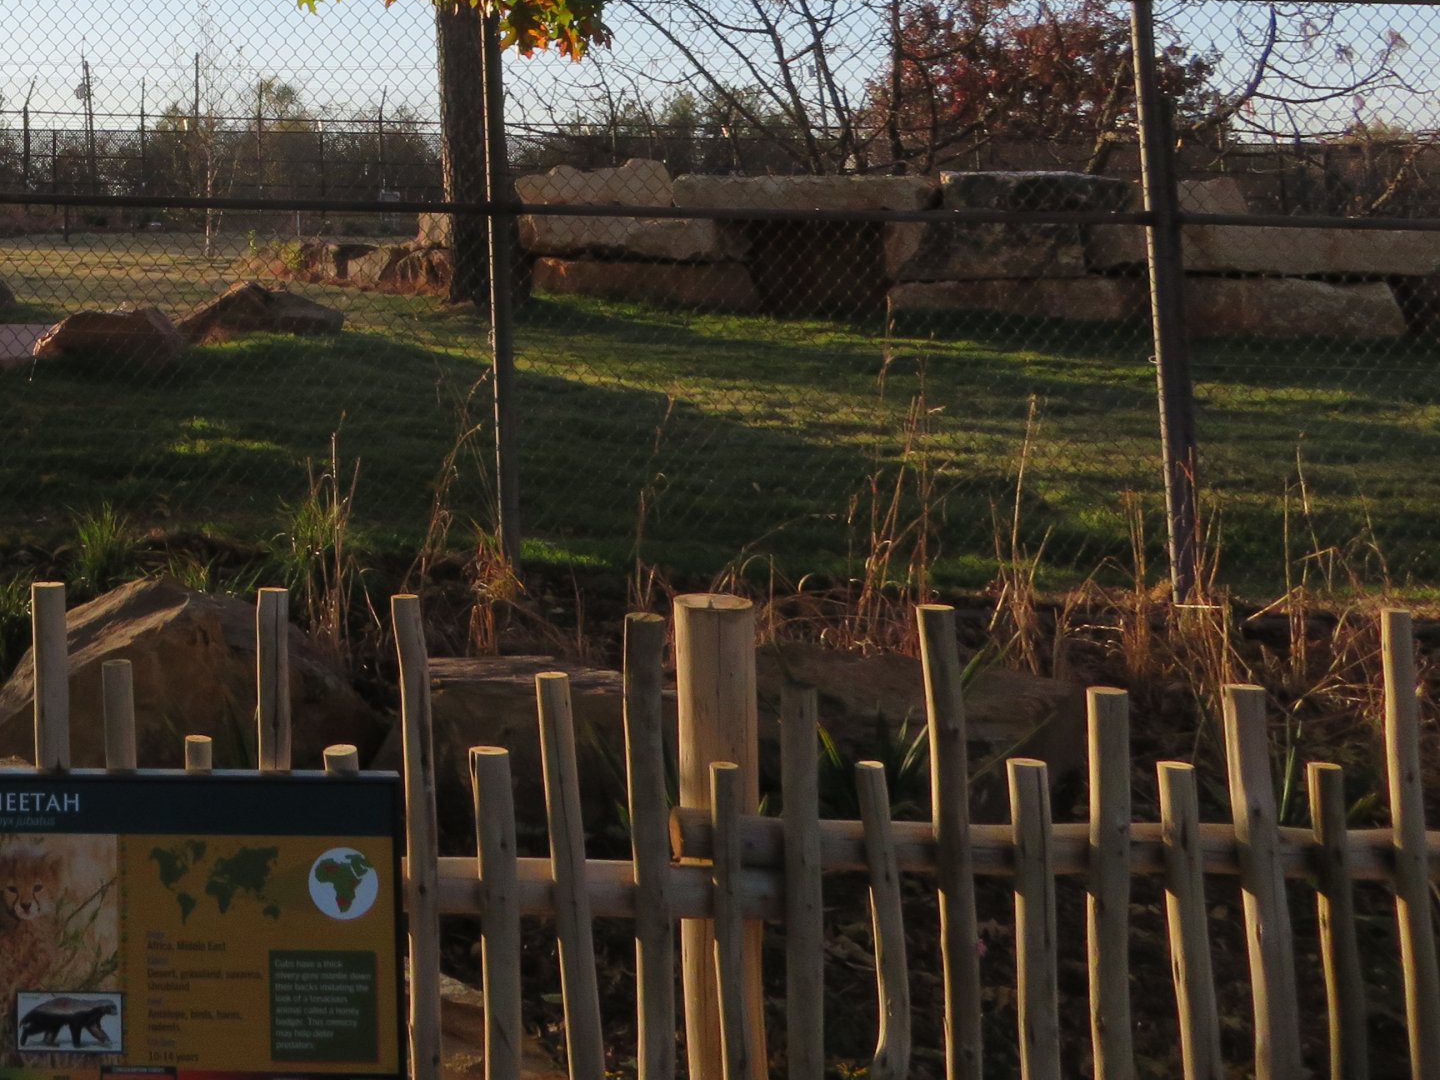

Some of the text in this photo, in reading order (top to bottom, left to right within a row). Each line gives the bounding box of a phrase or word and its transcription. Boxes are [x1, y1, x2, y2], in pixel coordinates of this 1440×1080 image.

[15, 815, 56, 826] jubatus
[208, 940, 225, 951] East
[294, 983, 318, 991] backs
[149, 1051, 199, 1063] 10-14 years
